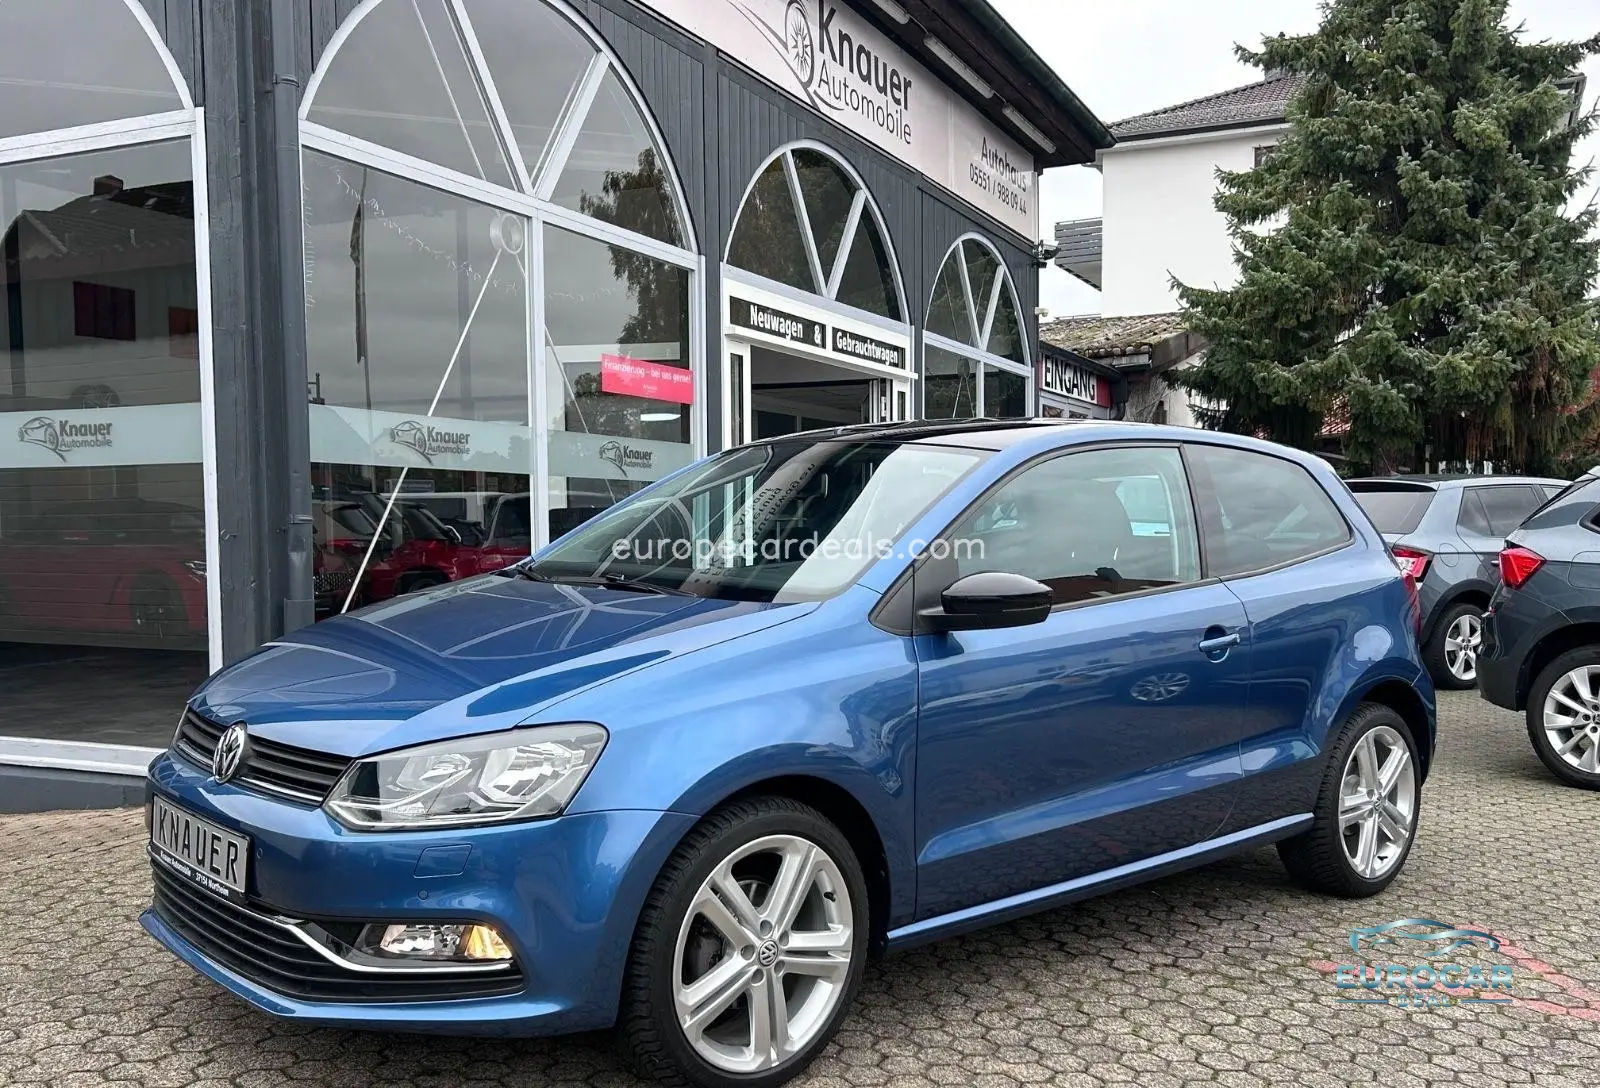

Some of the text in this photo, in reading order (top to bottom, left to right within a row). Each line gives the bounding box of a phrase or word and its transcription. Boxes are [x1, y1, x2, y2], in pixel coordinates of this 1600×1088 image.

[818, 0, 912, 111] Knauer
[818, 59, 912, 145] Automobile
[981, 136, 1027, 193] Autohaus
[969, 162, 991, 193] 05551
[1010, 191, 1019, 211] 09
[1019, 198, 1028, 217] 44
[750, 304, 823, 346] Neuwagen &
[836, 331, 898, 367] Gebrauchtwagen
[604, 359, 646, 378] Finanzierung
[651, 368, 661, 379] bei
[661, 371, 672, 381] uns
[1044, 354, 1096, 401] EINGANG
[59, 420, 113, 437] Knauer
[59, 436, 113, 448] Automobile
[427, 426, 470, 444] Knauer
[427, 442, 471, 455] Automobile
[623, 445, 653, 461] Knauer
[623, 457, 653, 469] Automobile
[160, 803, 240, 885] KNAUER
